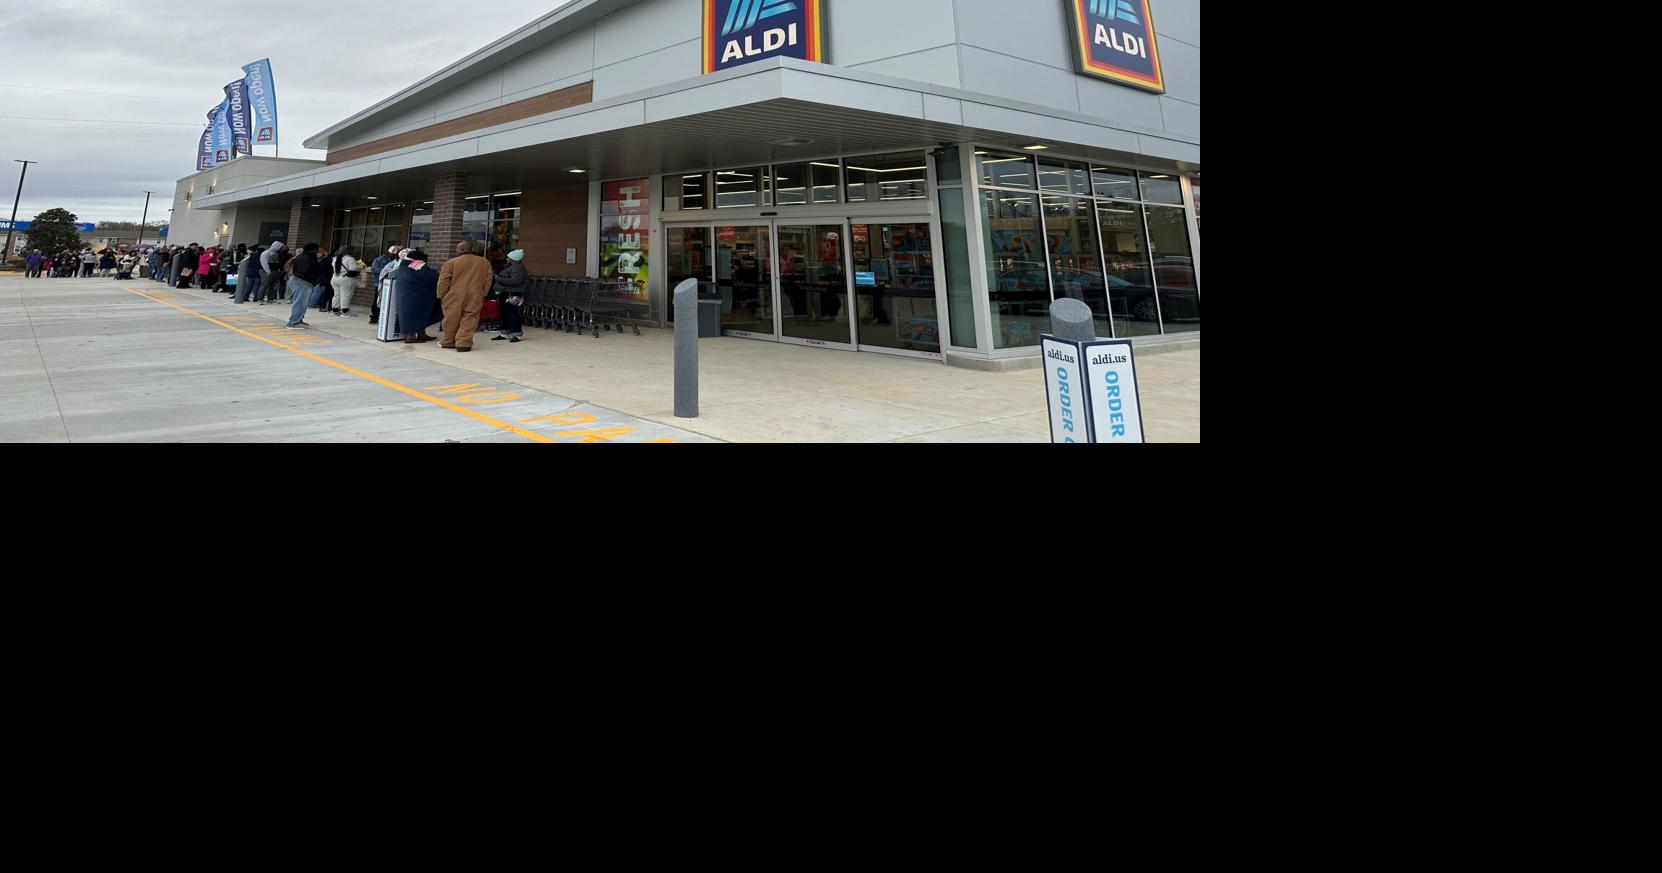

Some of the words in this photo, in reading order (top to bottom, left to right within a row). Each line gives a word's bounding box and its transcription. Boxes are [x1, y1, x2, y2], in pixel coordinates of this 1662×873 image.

[720, 22, 797, 64] ALDI
[1094, 23, 1147, 59] ALDI
[1047, 348, 1075, 364] aldi.us
[1092, 353, 1127, 365] aldi.us
[424, 383, 520, 404] NO
[1056, 366, 1074, 433] ORDER
[1104, 370, 1126, 438] ORDER
